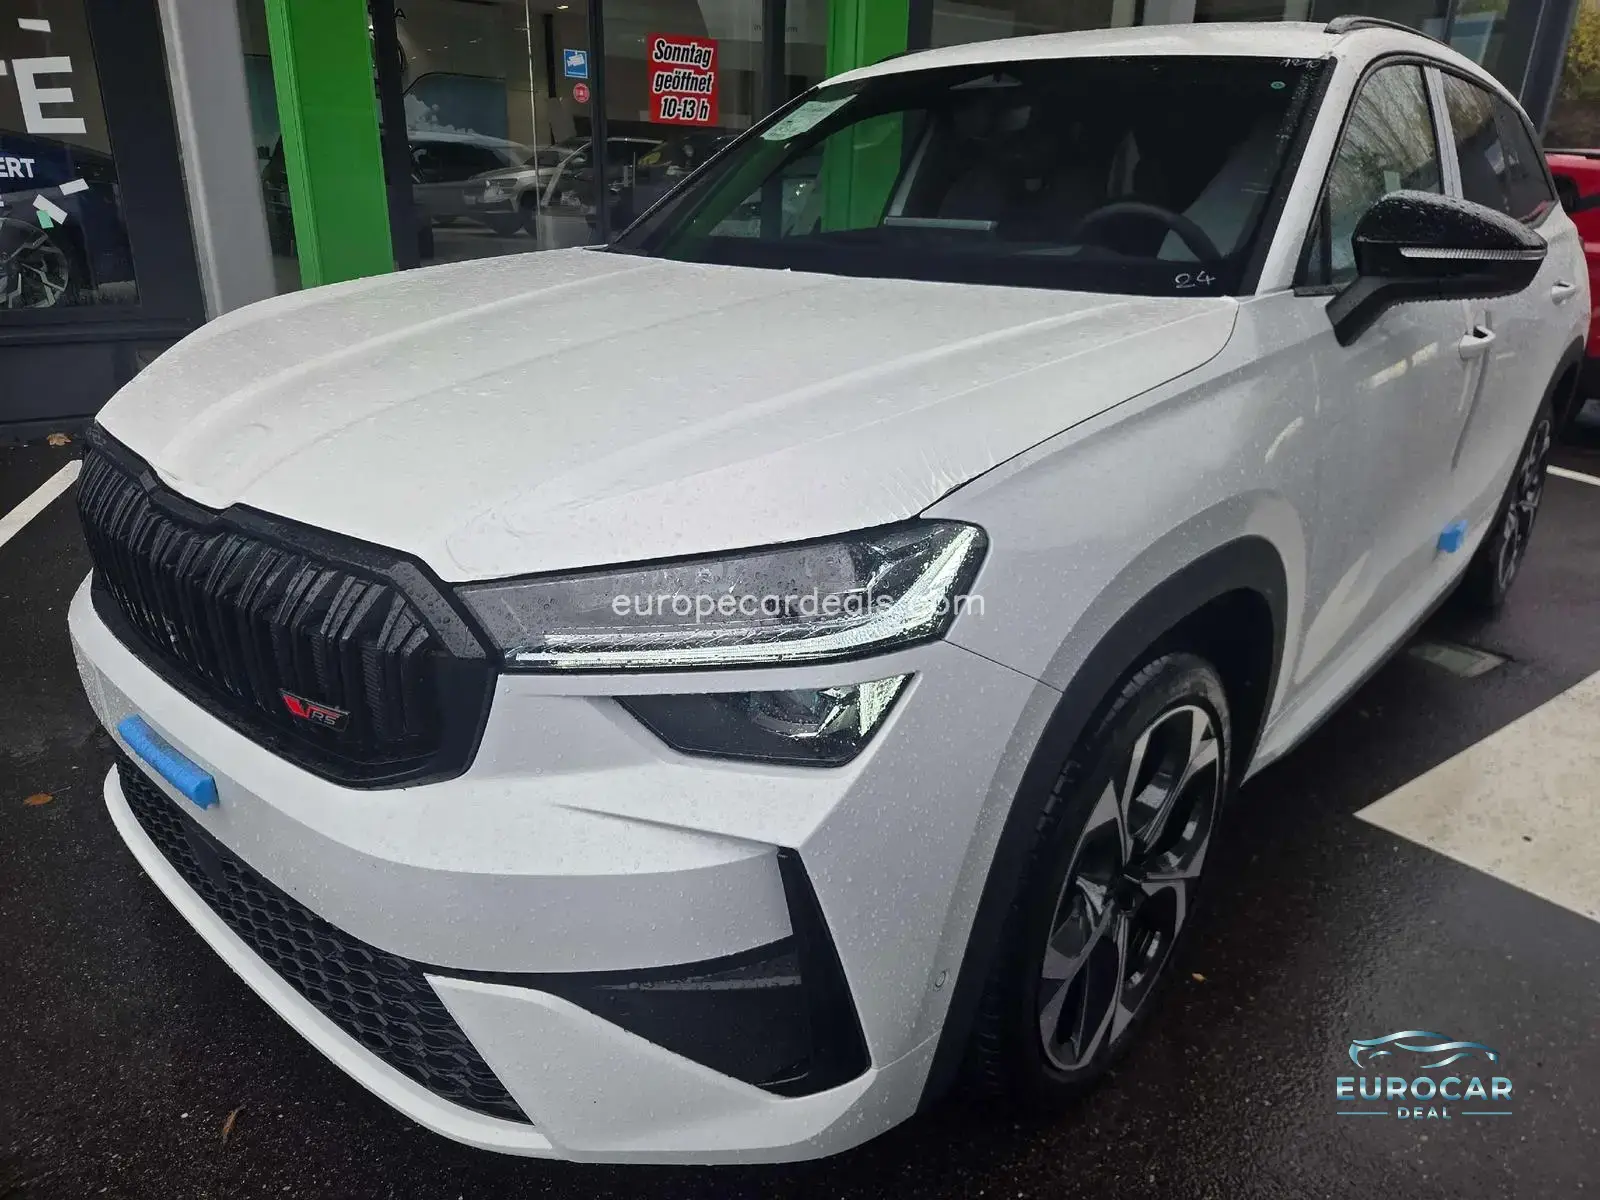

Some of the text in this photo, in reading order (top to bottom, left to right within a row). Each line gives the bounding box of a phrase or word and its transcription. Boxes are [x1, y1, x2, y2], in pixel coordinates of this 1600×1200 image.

[653, 38, 712, 70] Sonntag
[0, 56, 87, 134] E
[653, 69, 713, 94] geöffnet
[660, 97, 710, 121] 10-13 h
